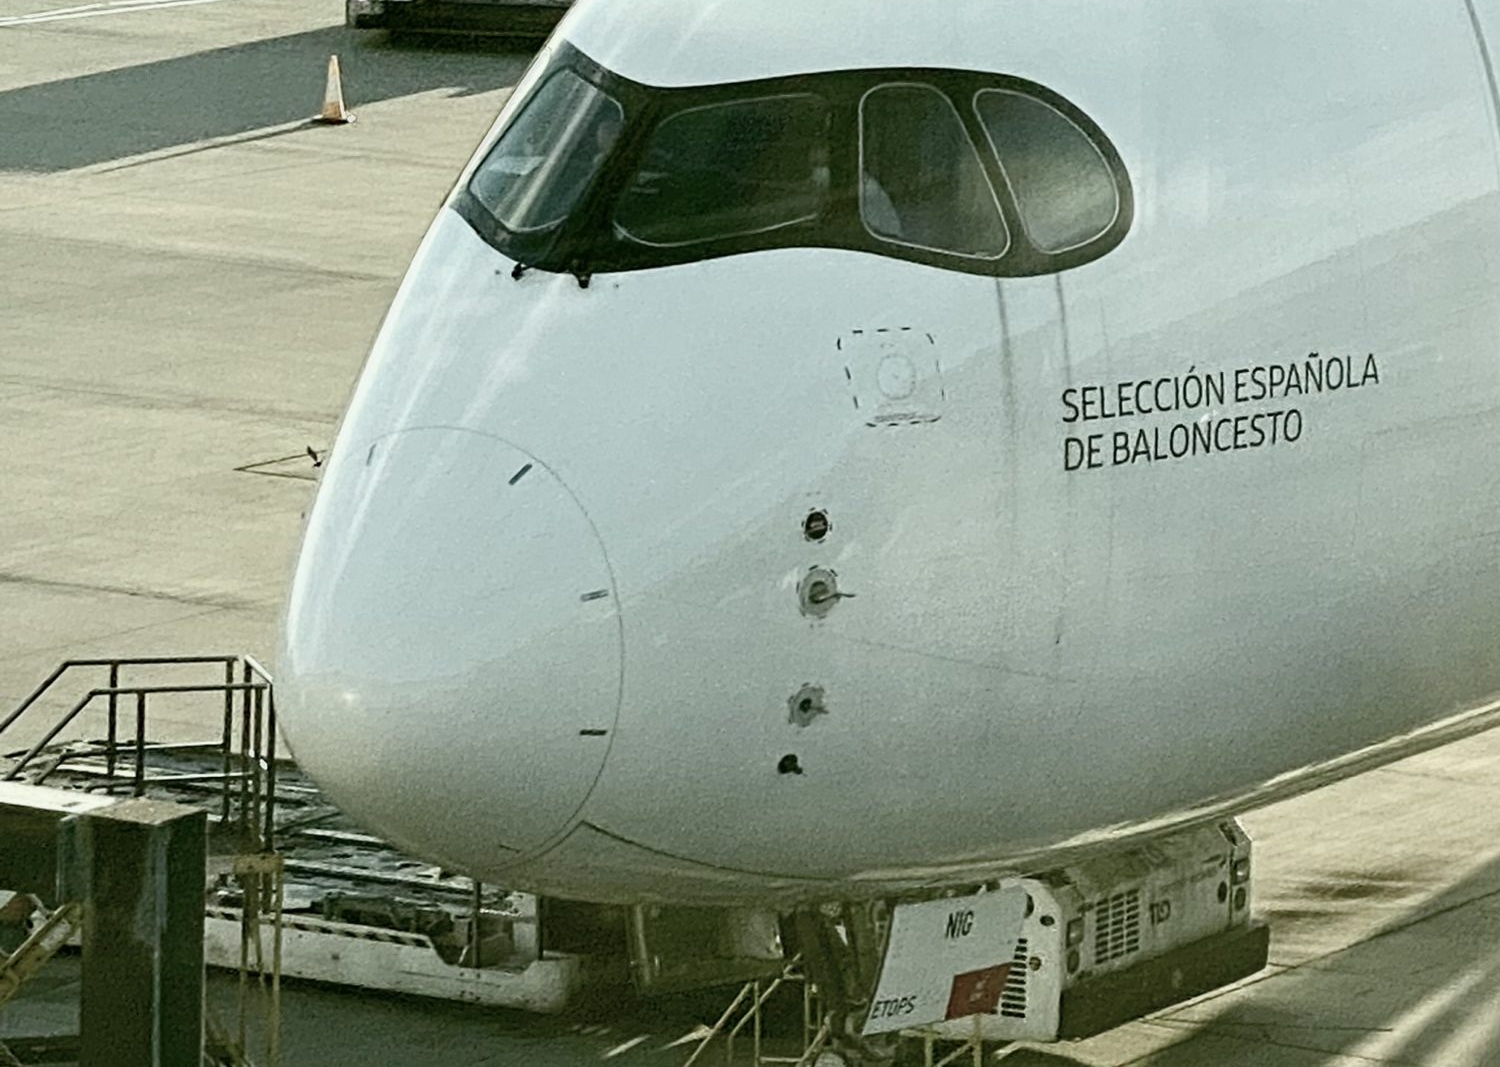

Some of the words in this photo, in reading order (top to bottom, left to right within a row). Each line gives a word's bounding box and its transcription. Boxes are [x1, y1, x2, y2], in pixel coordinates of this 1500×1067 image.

[1061, 365, 1225, 423] SELECCIÓN
[1234, 351, 1380, 404] ESPAÑOLA
[1063, 433, 1103, 471] DE
[1112, 408, 1303, 466] BALONCESTO
[945, 910, 975, 939] NIG
[871, 995, 917, 1020] ETOPS
